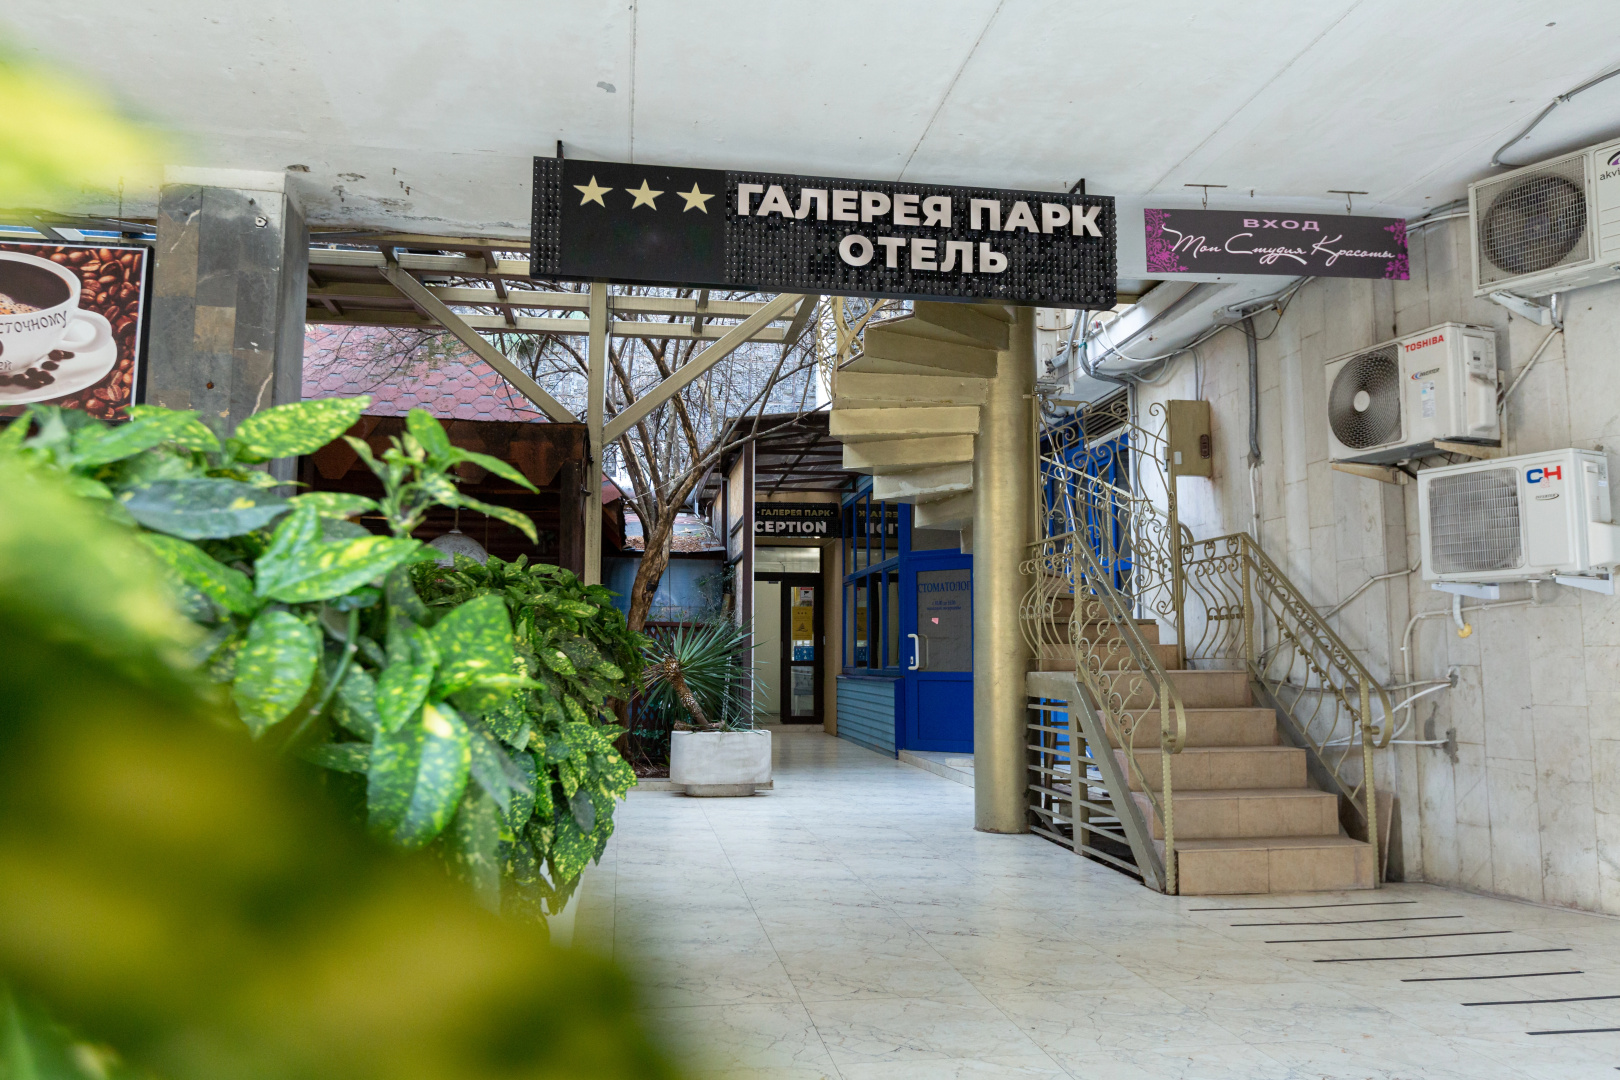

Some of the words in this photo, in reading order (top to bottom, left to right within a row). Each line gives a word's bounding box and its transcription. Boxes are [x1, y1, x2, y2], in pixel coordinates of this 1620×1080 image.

[737, 183, 952, 228] ГАЛЕРЕЯ
[970, 198, 1103, 238] ПАРК
[1243, 218, 1320, 232] ВХОД
[838, 234, 1009, 274] ОТЕЛЬ
[1224, 232, 1308, 266] Студия
[1311, 234, 1396, 267] Красоты
[1404, 334, 1445, 353] TOSHIBA
[760, 508, 803, 517] ГАЛЕРЕЯ
[804, 509, 831, 517] ПАРК
[755, 520, 827, 534] CEPTION
